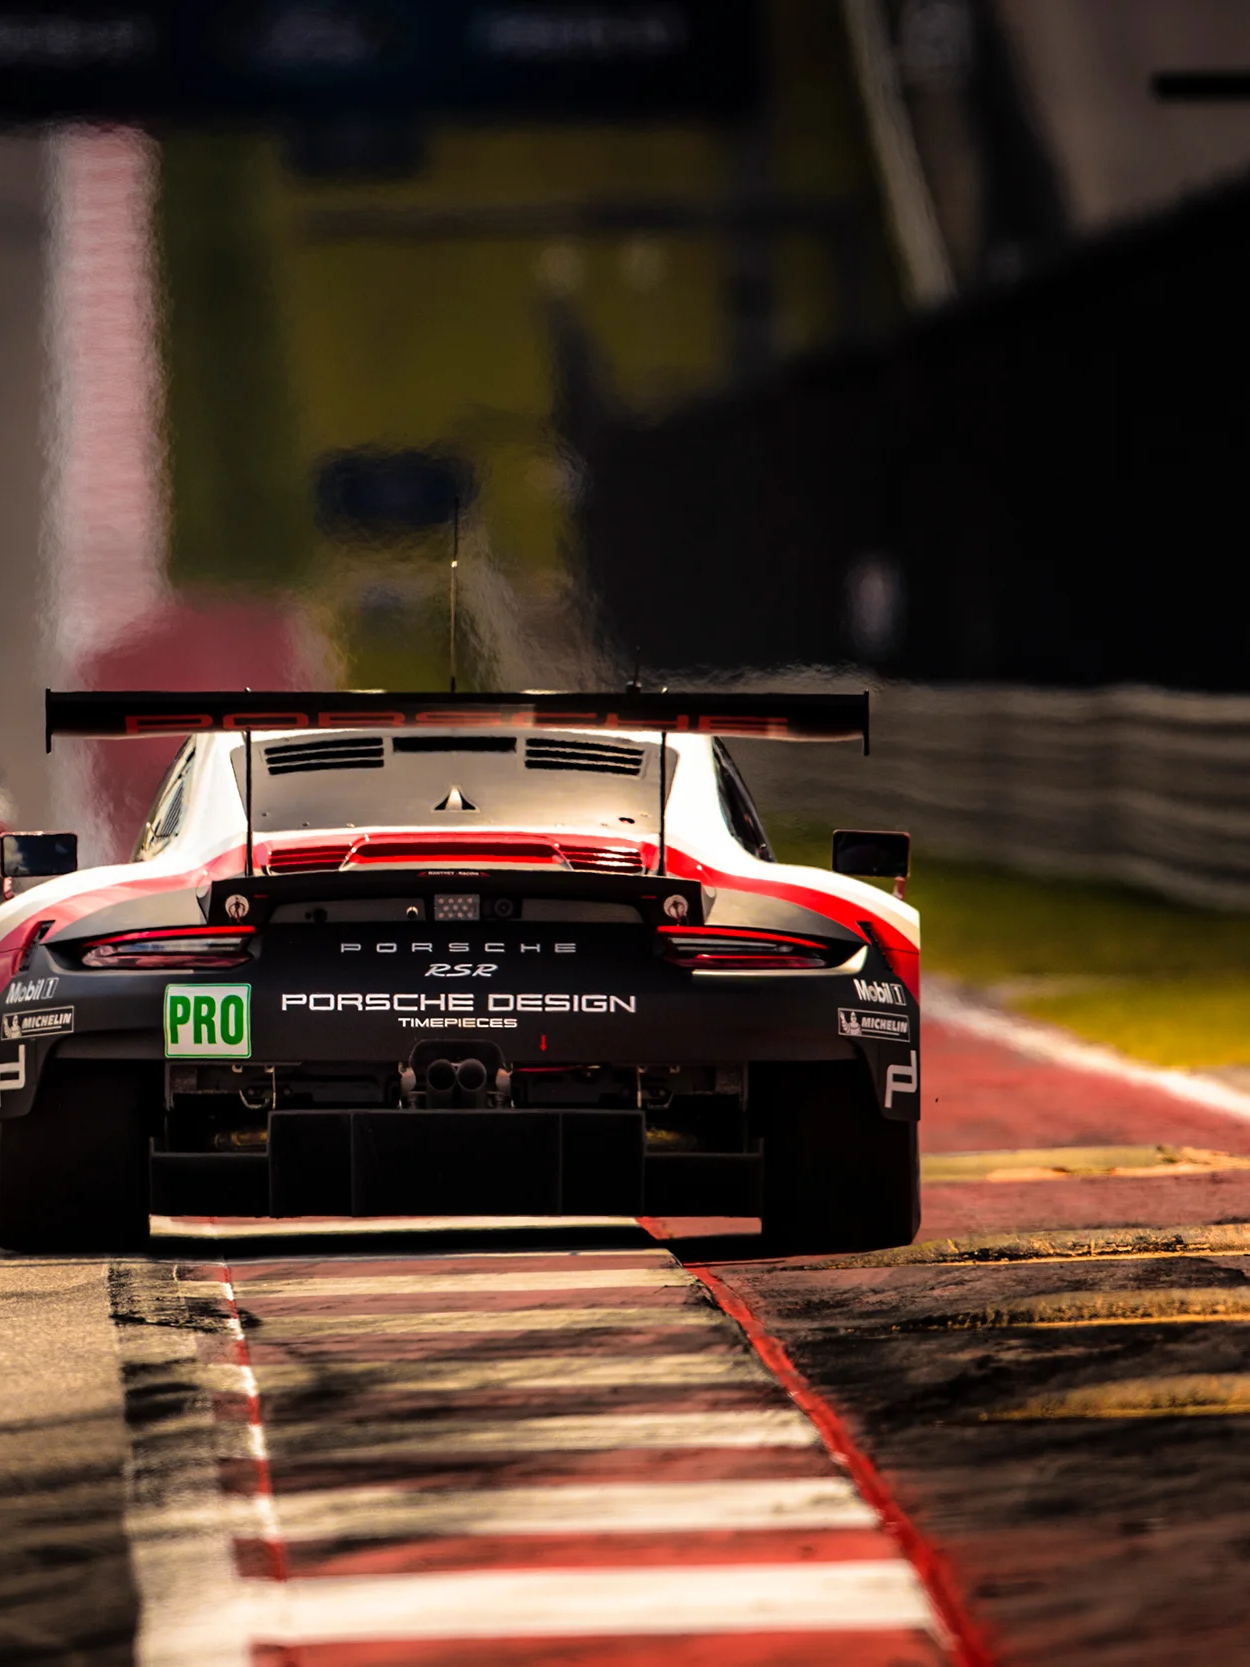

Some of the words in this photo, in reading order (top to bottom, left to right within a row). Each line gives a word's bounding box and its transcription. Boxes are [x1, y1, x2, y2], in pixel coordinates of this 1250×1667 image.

[125, 711, 788, 734] PORSCHE
[339, 942, 578, 954] PORSCHE
[423, 963, 499, 978] RSR
[5, 978, 44, 1004] Mobil
[852, 978, 893, 1004] Mobil
[281, 993, 475, 1012] PORSCHE
[487, 993, 638, 1014] DESIGN
[21, 1013, 73, 1030] MICHELIN
[169, 994, 245, 1046] PRO
[397, 1017, 519, 1029] TIMEPIECES
[860, 1016, 908, 1034] MICHELIN
